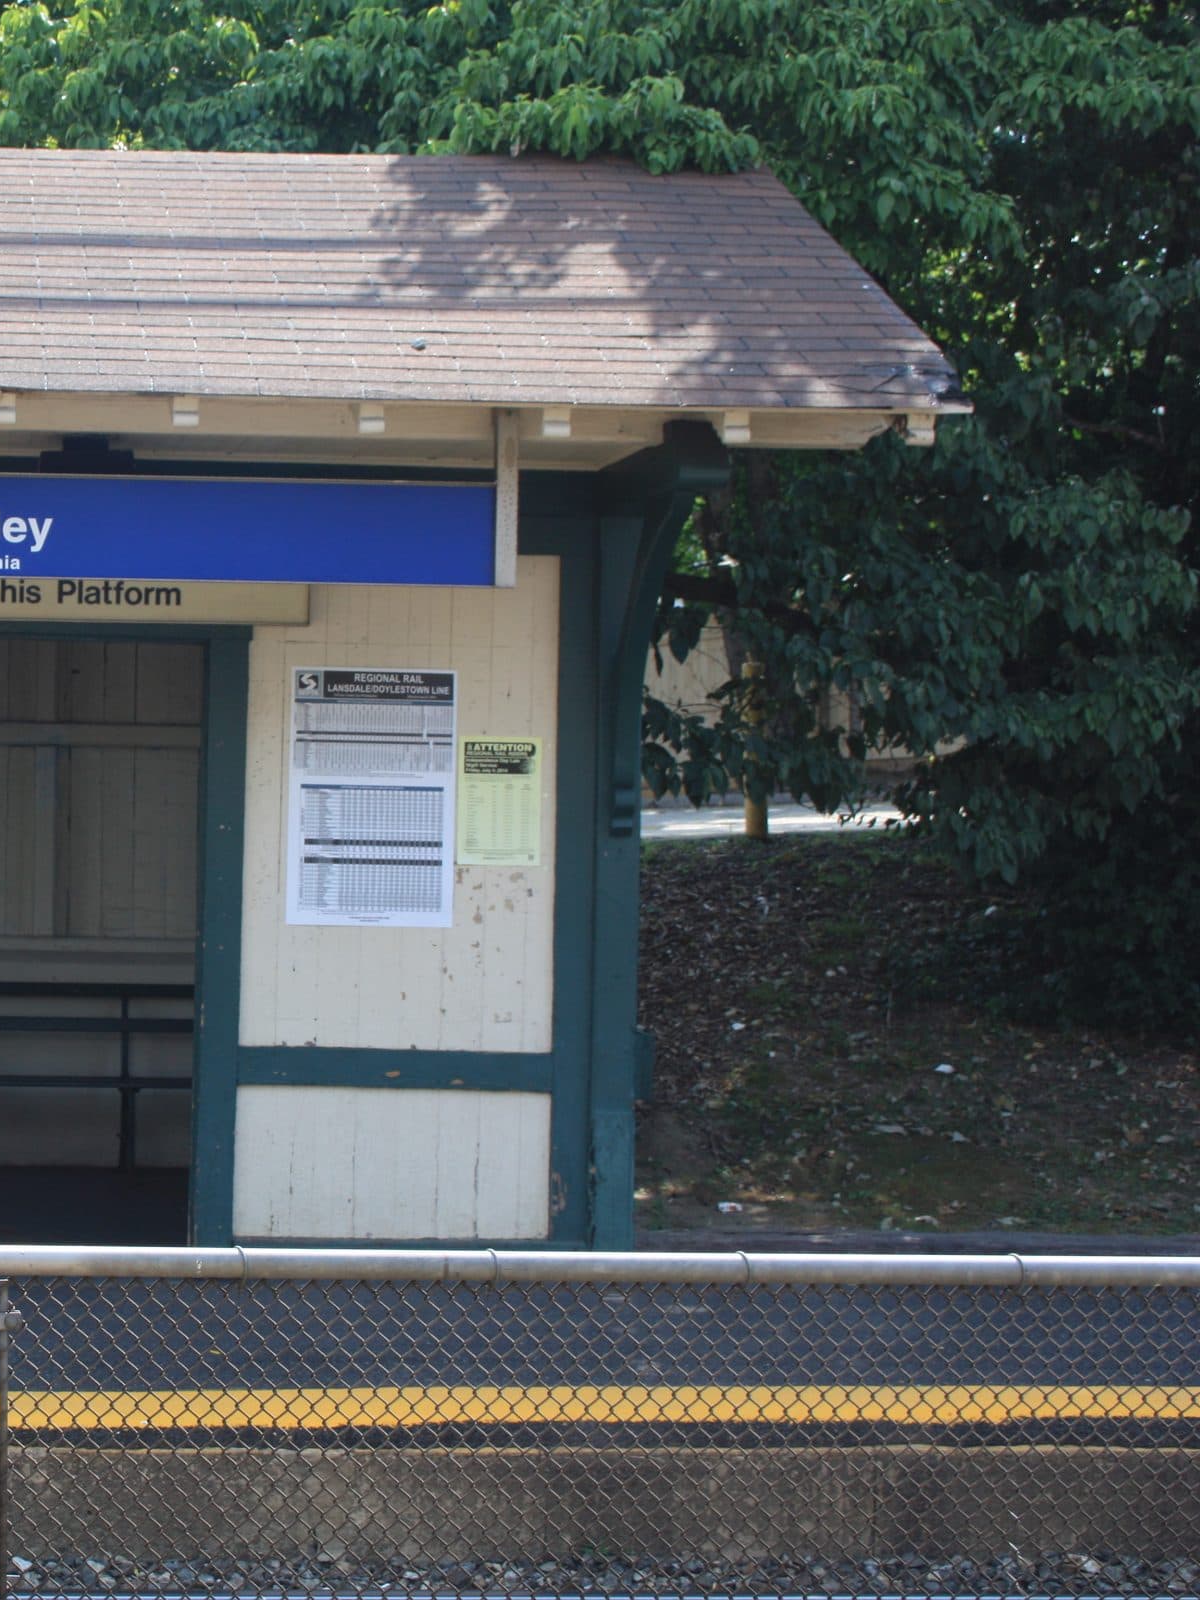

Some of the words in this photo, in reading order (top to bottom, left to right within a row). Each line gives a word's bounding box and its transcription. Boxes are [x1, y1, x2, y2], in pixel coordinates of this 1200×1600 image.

[57, 579, 182, 607] Platform
[354, 673, 400, 683] REGIONAL
[403, 674, 424, 683] RAIL
[431, 685, 449, 695] LINE
[474, 743, 532, 752] ATTENTION
